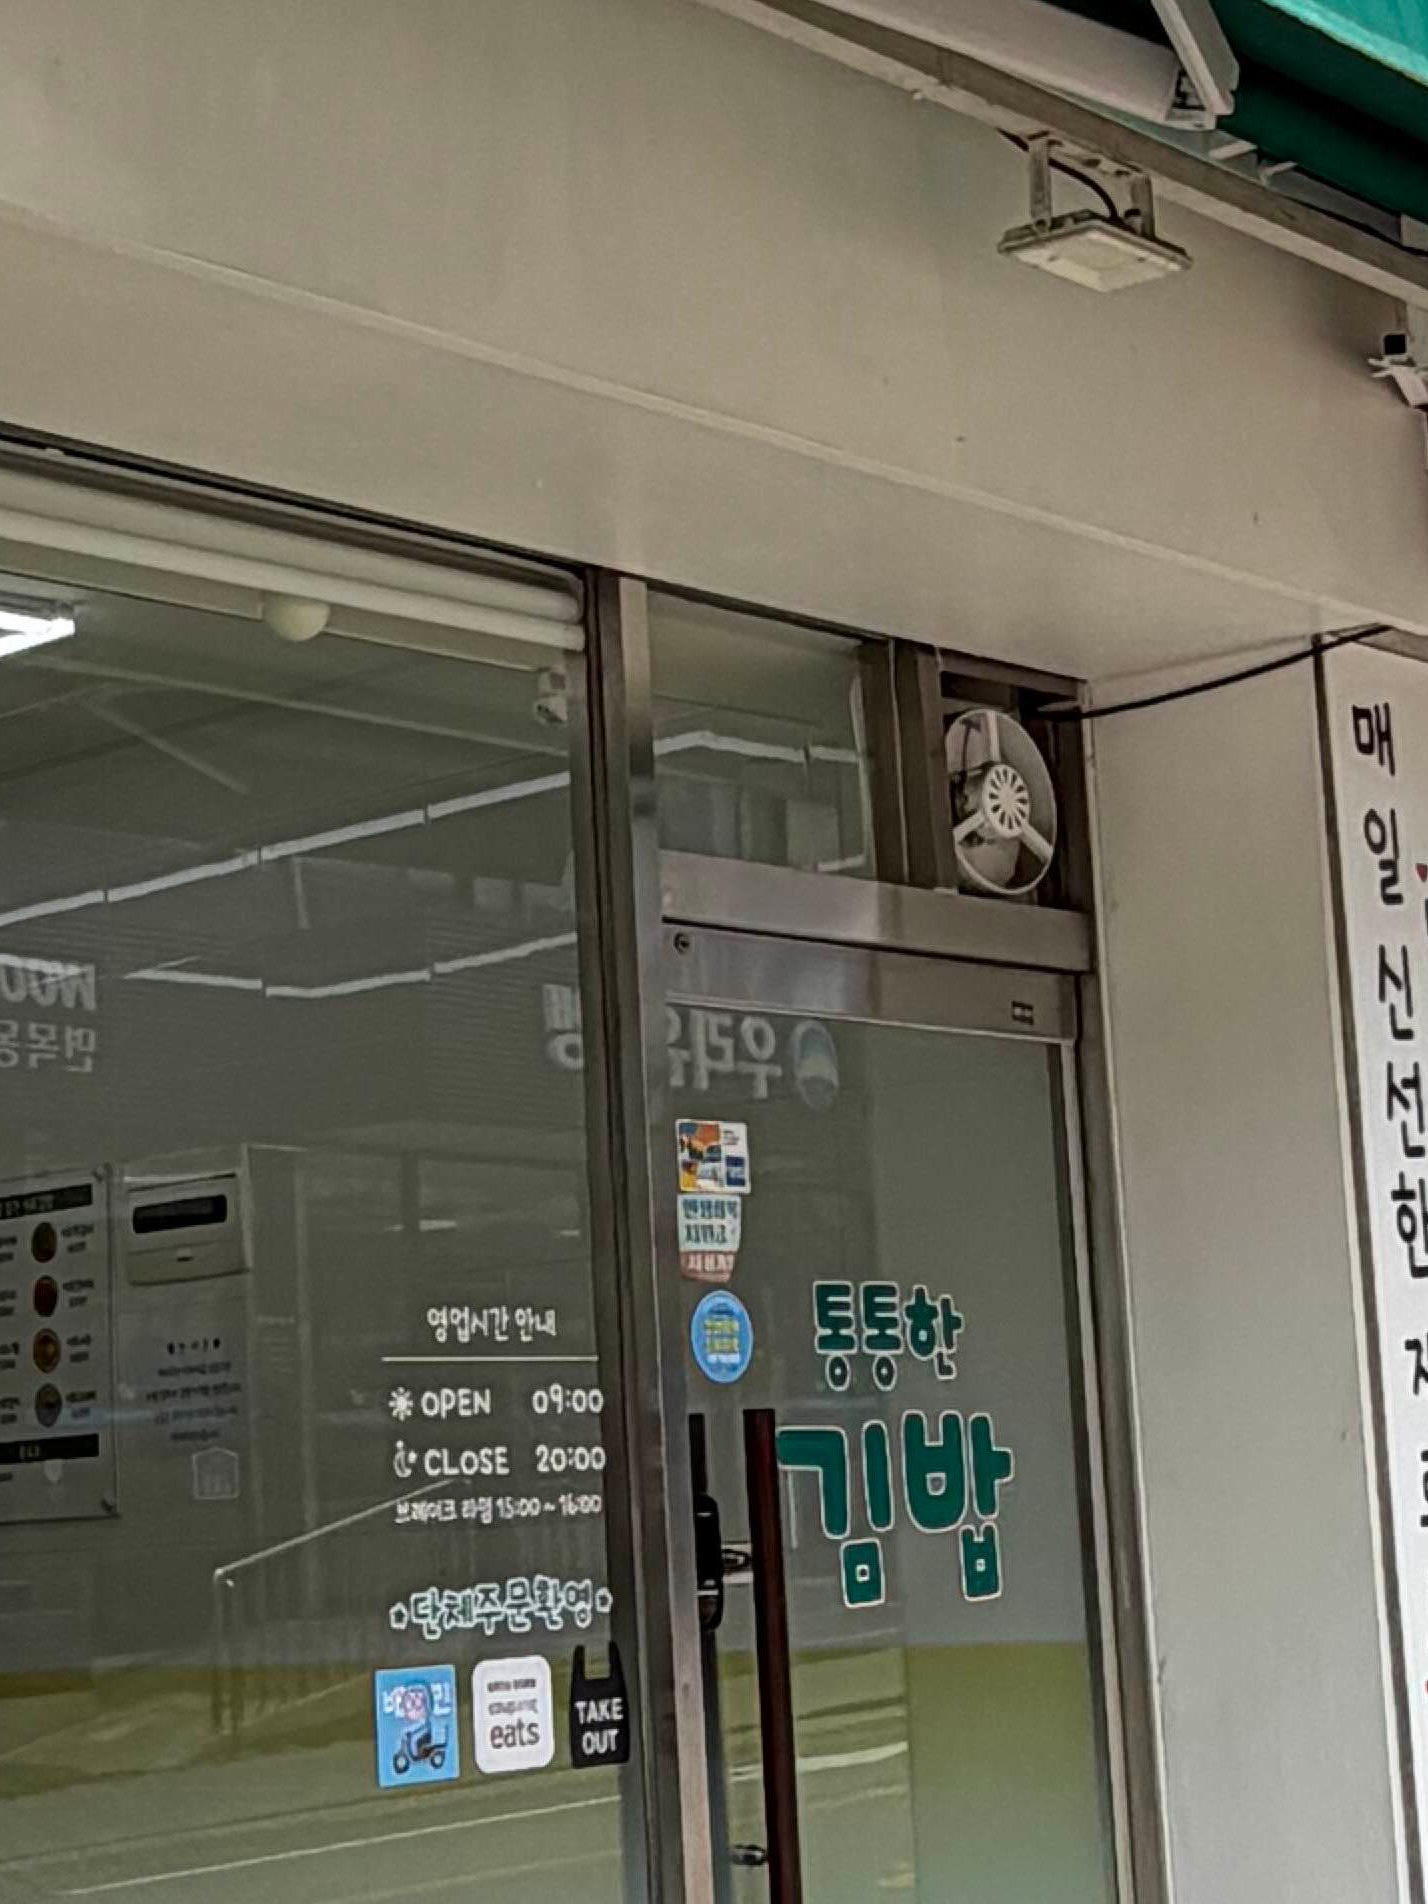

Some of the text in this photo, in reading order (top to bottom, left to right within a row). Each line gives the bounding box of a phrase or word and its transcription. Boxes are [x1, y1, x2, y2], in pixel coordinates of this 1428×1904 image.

[1352, 702, 1404, 906] 매일
[427, 1305, 558, 1343] 영업시간 안내
[813, 1280, 964, 1391] 통통한
[421, 1383, 604, 1419] OPEN 09:00
[424, 1445, 606, 1476] CLOSE 20:00
[775, 1409, 1014, 1608] 김밥
[410, 1574, 593, 1641] 단체주문환영
[575, 1697, 624, 1725] TAKE
[490, 1720, 541, 1750] eats
[582, 1729, 620, 1756] OUT
